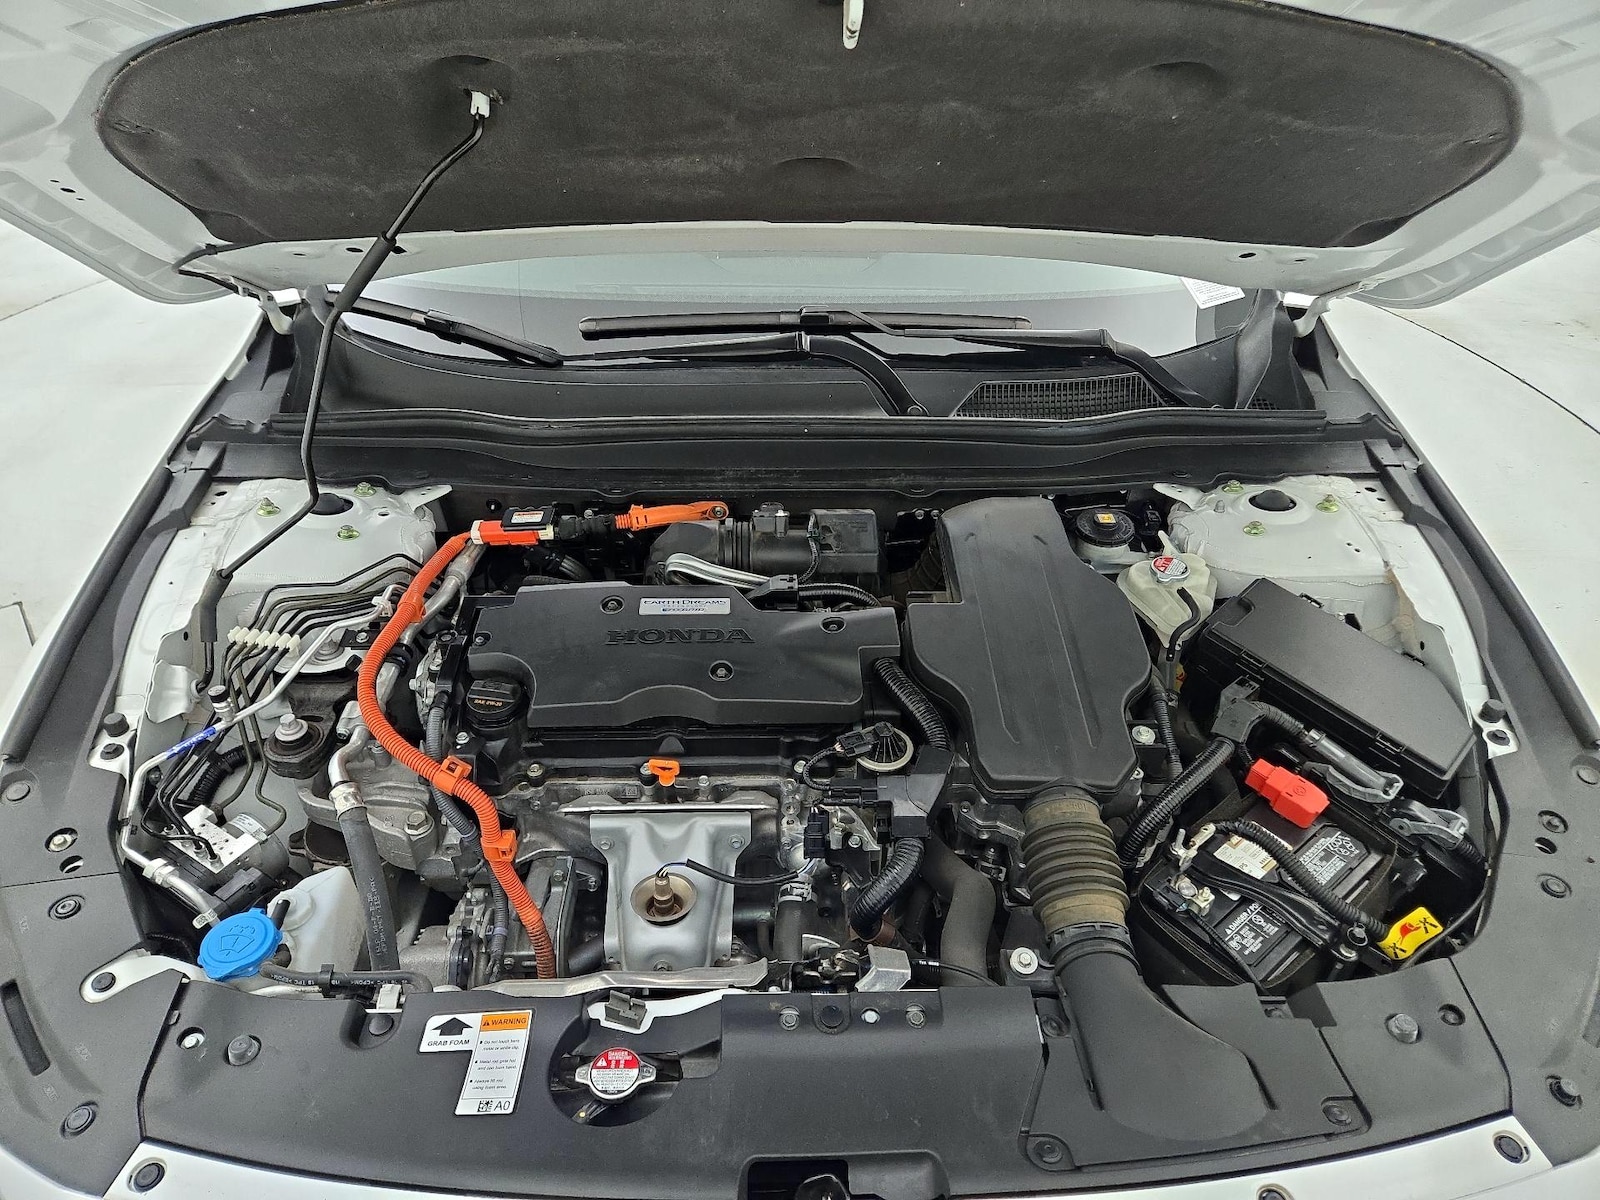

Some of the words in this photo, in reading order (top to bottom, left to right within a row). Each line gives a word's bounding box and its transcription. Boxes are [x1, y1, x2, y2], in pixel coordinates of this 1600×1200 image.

[605, 627, 755, 645] HONDA
[1228, 911, 1250, 931] DANGER
[491, 1017, 527, 1026] WARNING
[427, 1039, 448, 1047] GRAB
[493, 1100, 511, 1111] A0
